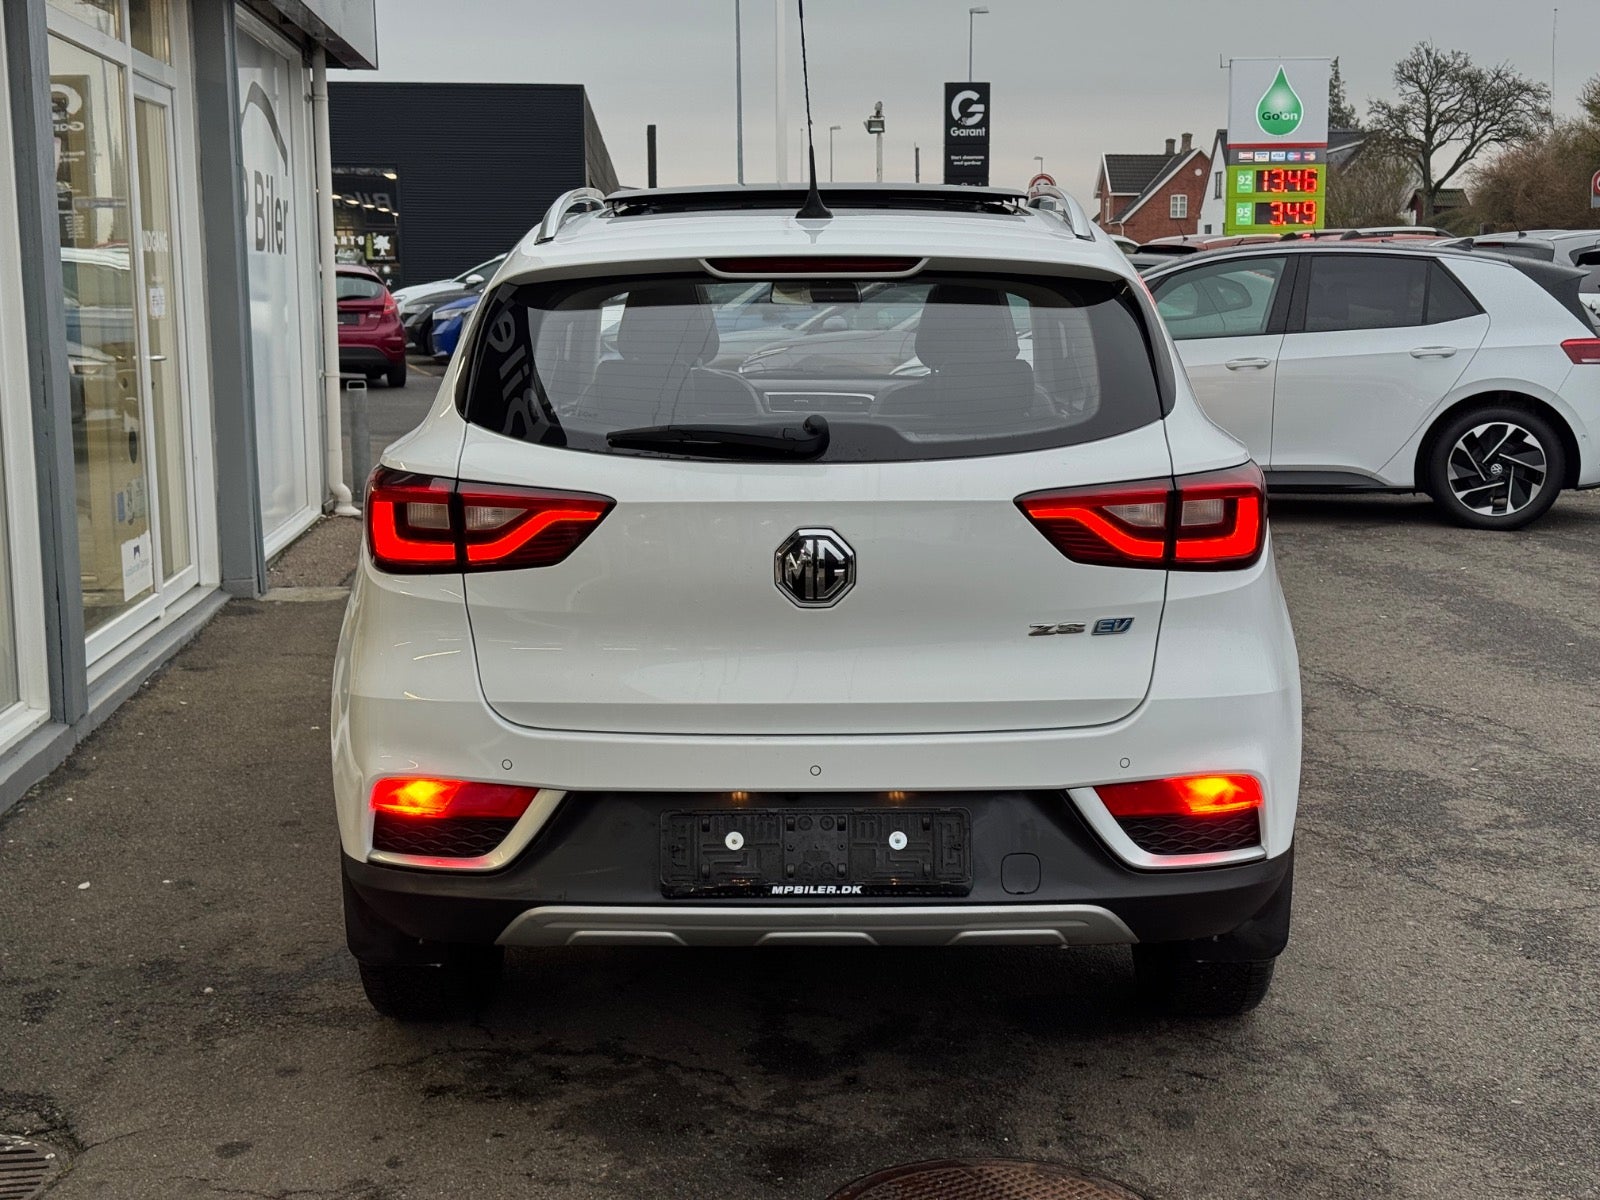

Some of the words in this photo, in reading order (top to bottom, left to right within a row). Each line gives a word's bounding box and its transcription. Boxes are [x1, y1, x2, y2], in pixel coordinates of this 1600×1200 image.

[1261, 111, 1298, 121] Go'on
[950, 127, 986, 137] Garant
[1237, 175, 1252, 184] 92
[1262, 168, 1319, 193] 13.46
[254, 170, 288, 255] Biler
[1236, 207, 1252, 217] 95
[1269, 200, 1316, 226] 3.49
[779, 536, 848, 602] MG
[1028, 621, 1087, 637] ZS
[1096, 618, 1131, 633] EV
[771, 885, 863, 895] MPBILER.DK
